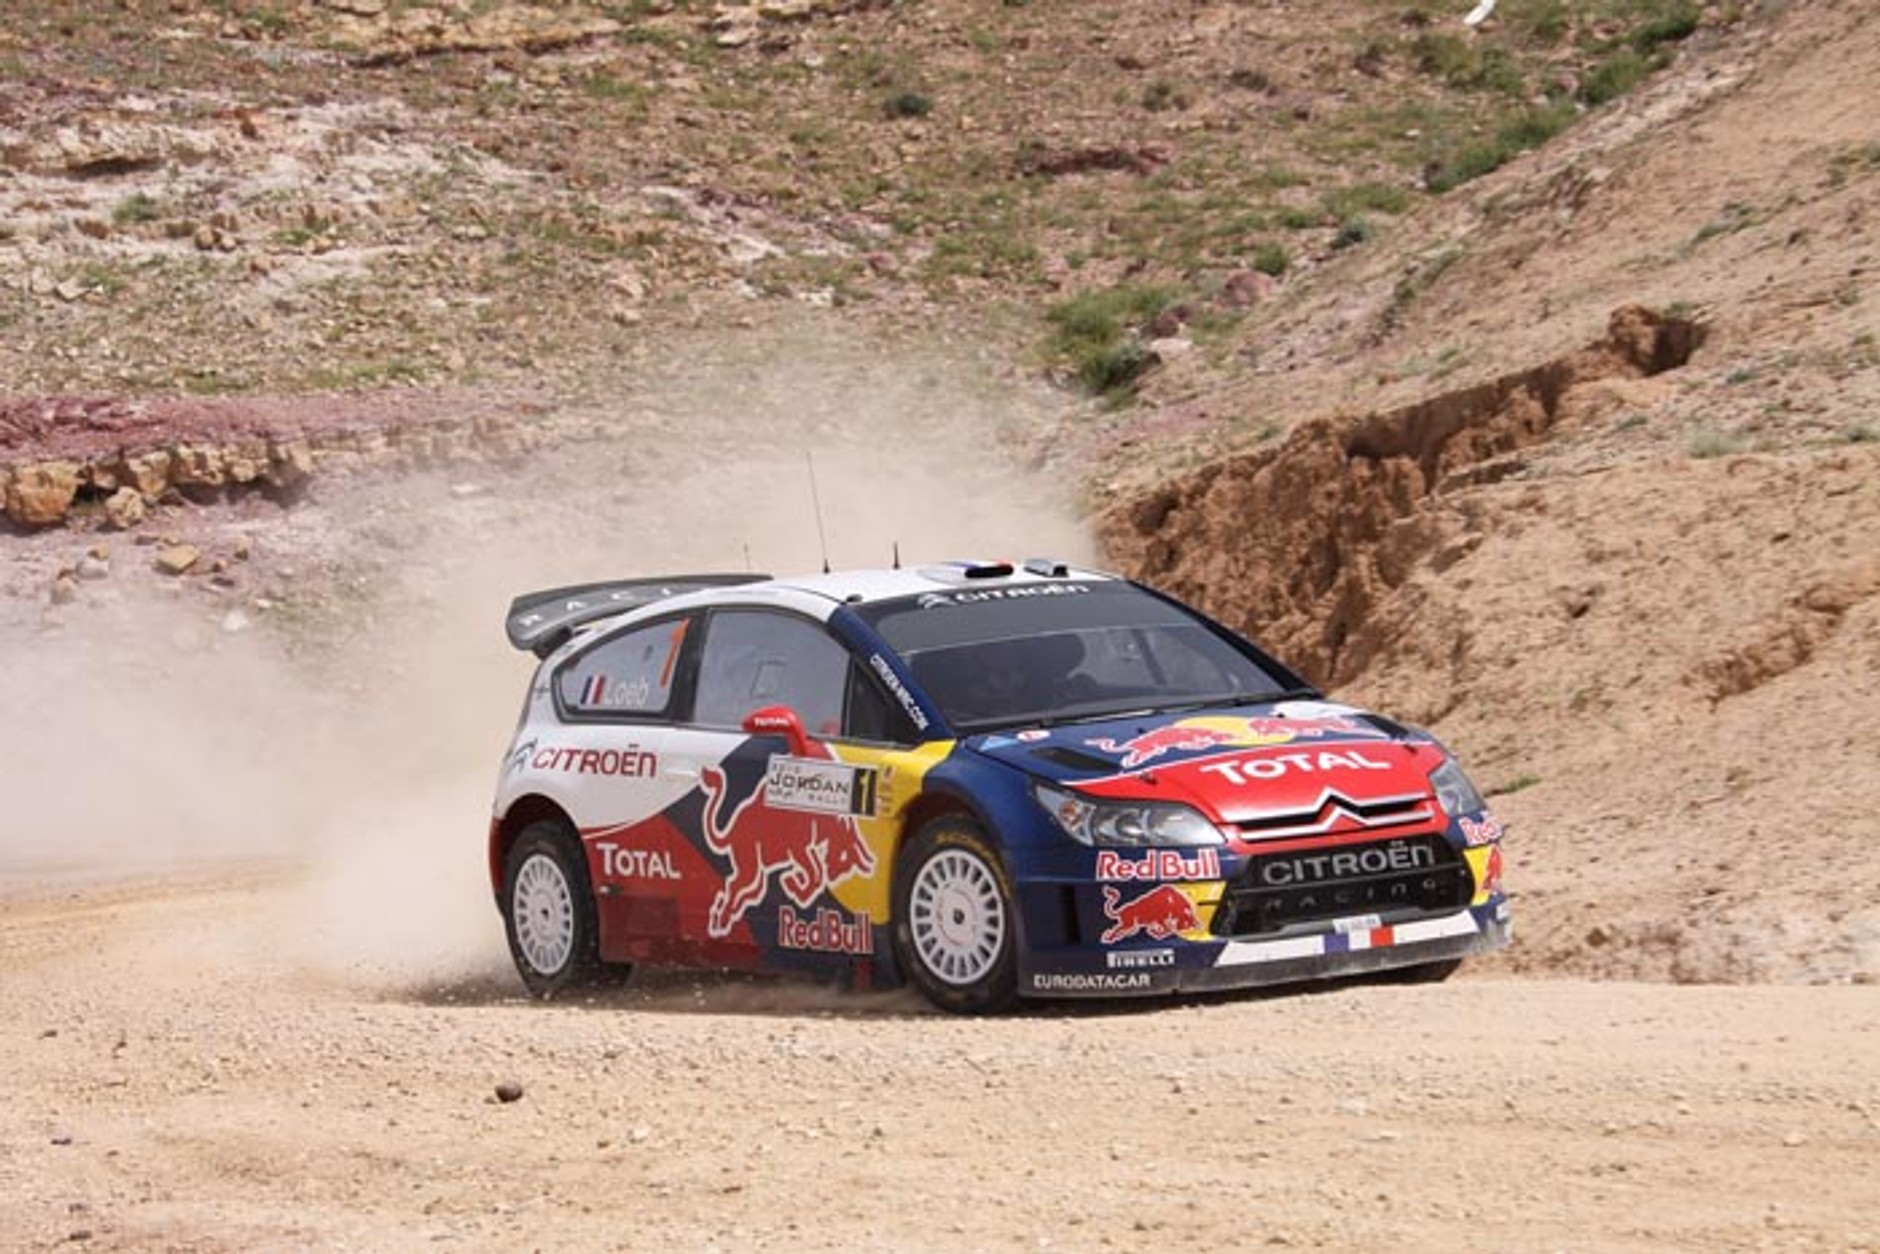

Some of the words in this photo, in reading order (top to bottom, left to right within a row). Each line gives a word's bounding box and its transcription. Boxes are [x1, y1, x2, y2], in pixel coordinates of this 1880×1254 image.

[659, 617, 689, 689] 1
[770, 773, 850, 794] JORDAN
[1199, 751, 1393, 785] TOTAL
[859, 768, 873, 816] 1
[597, 842, 682, 880] TOTAL
[1096, 849, 1156, 881] Red
[1160, 848, 1220, 879] Bull
[779, 905, 825, 949] Red
[826, 908, 874, 955] Bull
[1106, 948, 1175, 969] PIRELLI
[1033, 973, 1151, 989] EURODATACAR
